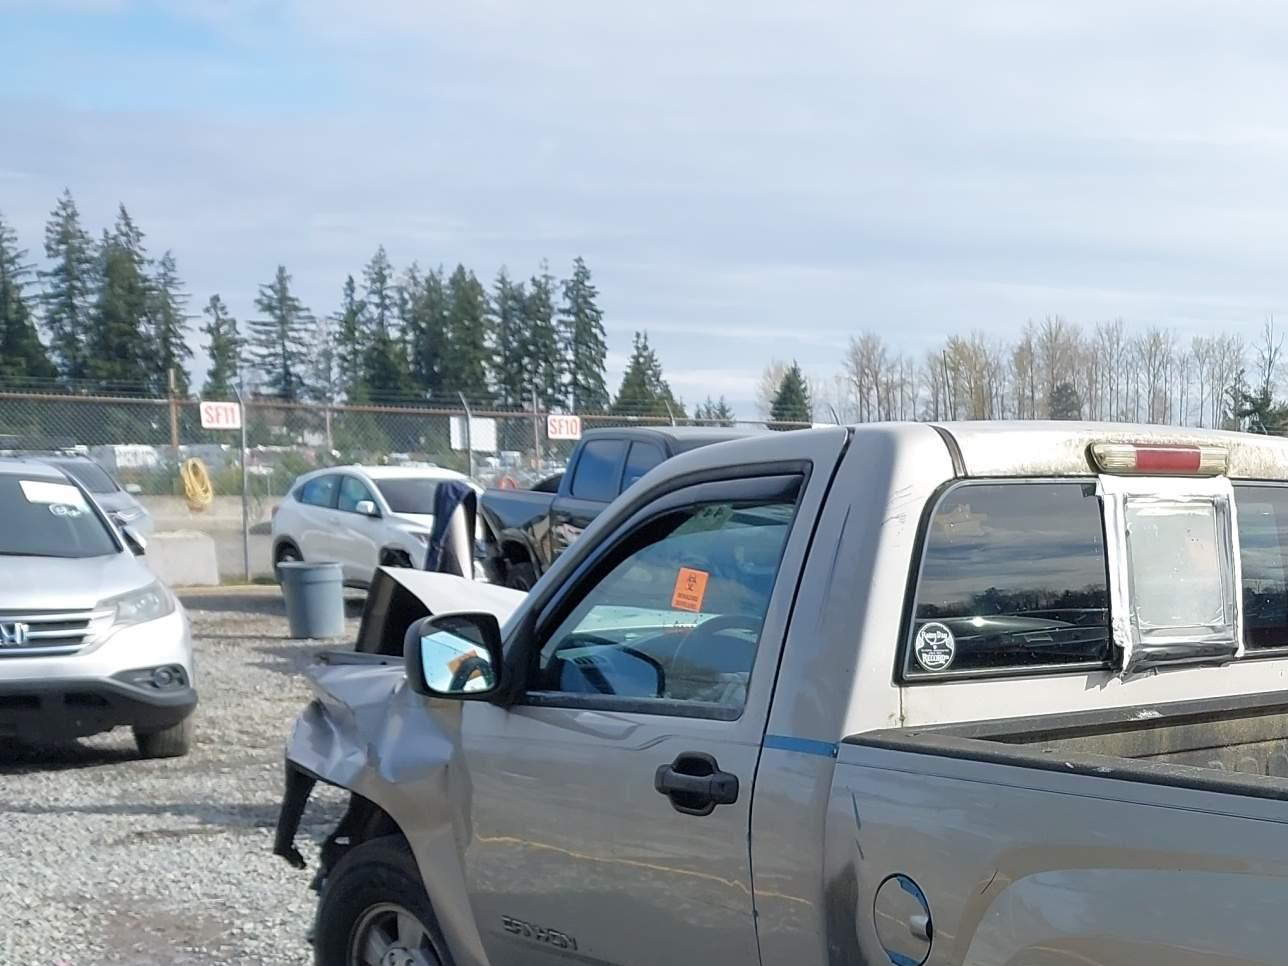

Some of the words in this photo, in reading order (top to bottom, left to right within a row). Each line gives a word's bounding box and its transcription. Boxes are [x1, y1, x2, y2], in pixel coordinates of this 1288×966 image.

[204, 405, 236, 425] SF11
[549, 418, 578, 436] SF10
[501, 914, 578, 951] CANYON
